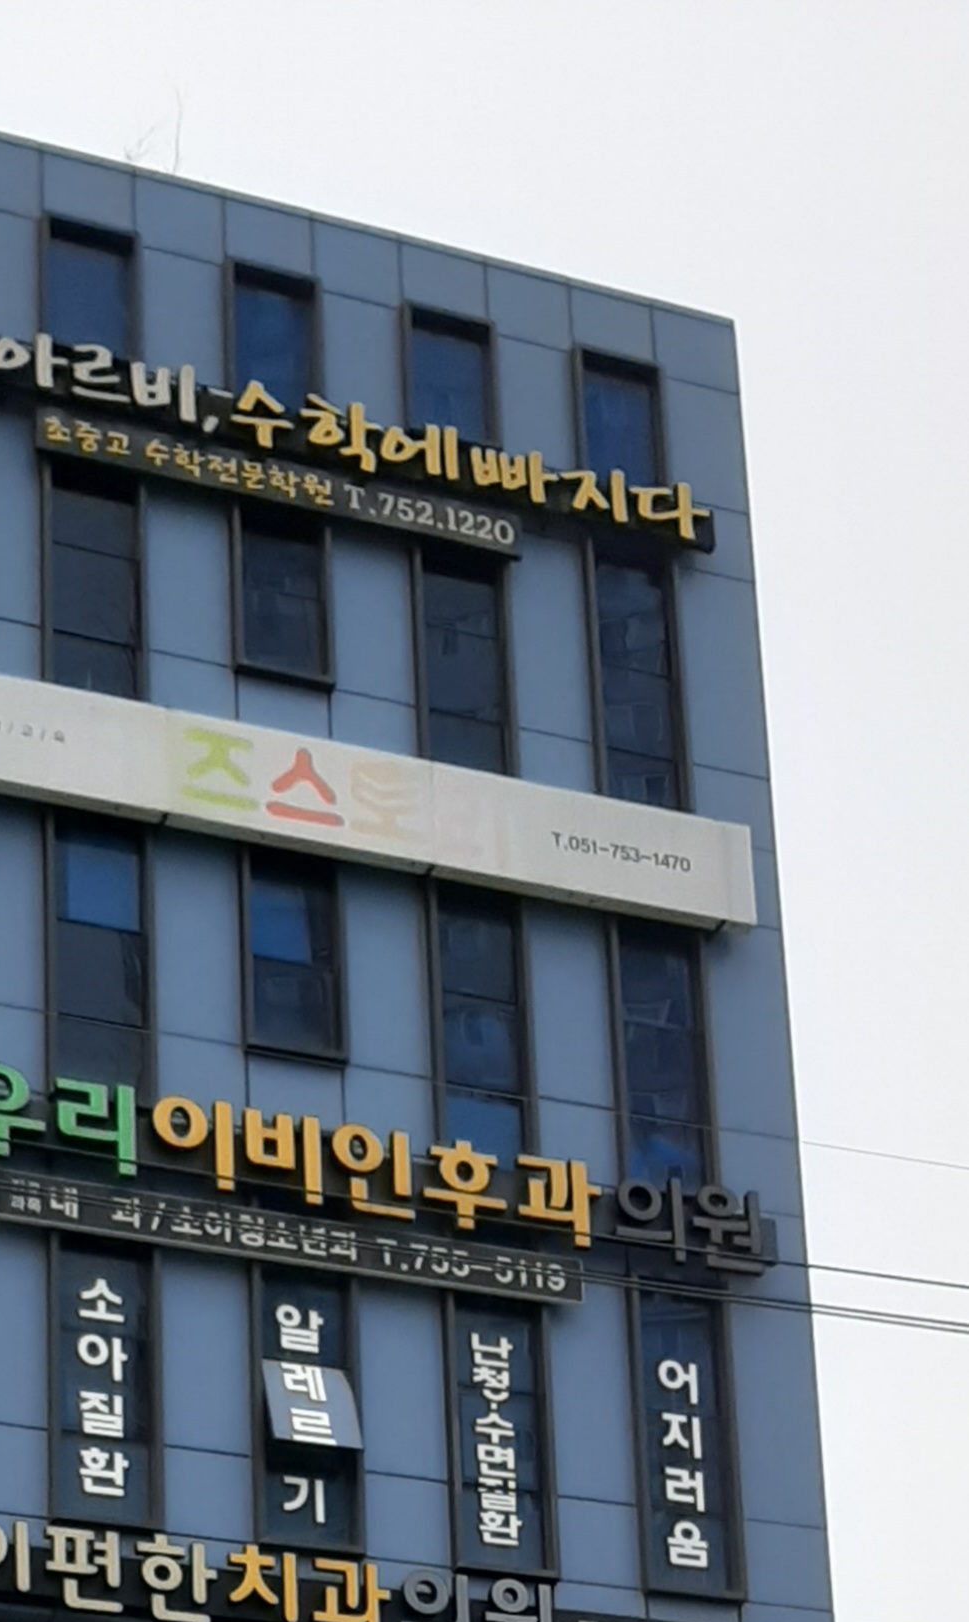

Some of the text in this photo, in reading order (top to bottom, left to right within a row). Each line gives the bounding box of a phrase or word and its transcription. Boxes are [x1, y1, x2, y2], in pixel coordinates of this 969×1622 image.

[44, 415, 516, 545] 초중고 수학전문학원 T.752.1220
[469, 450, 712, 540] 빠지다
[551, 831, 692, 873] T.051-753-1470
[77, 1277, 130, 1498] 소아질환
[657, 1358, 710, 1570] 어지러움
